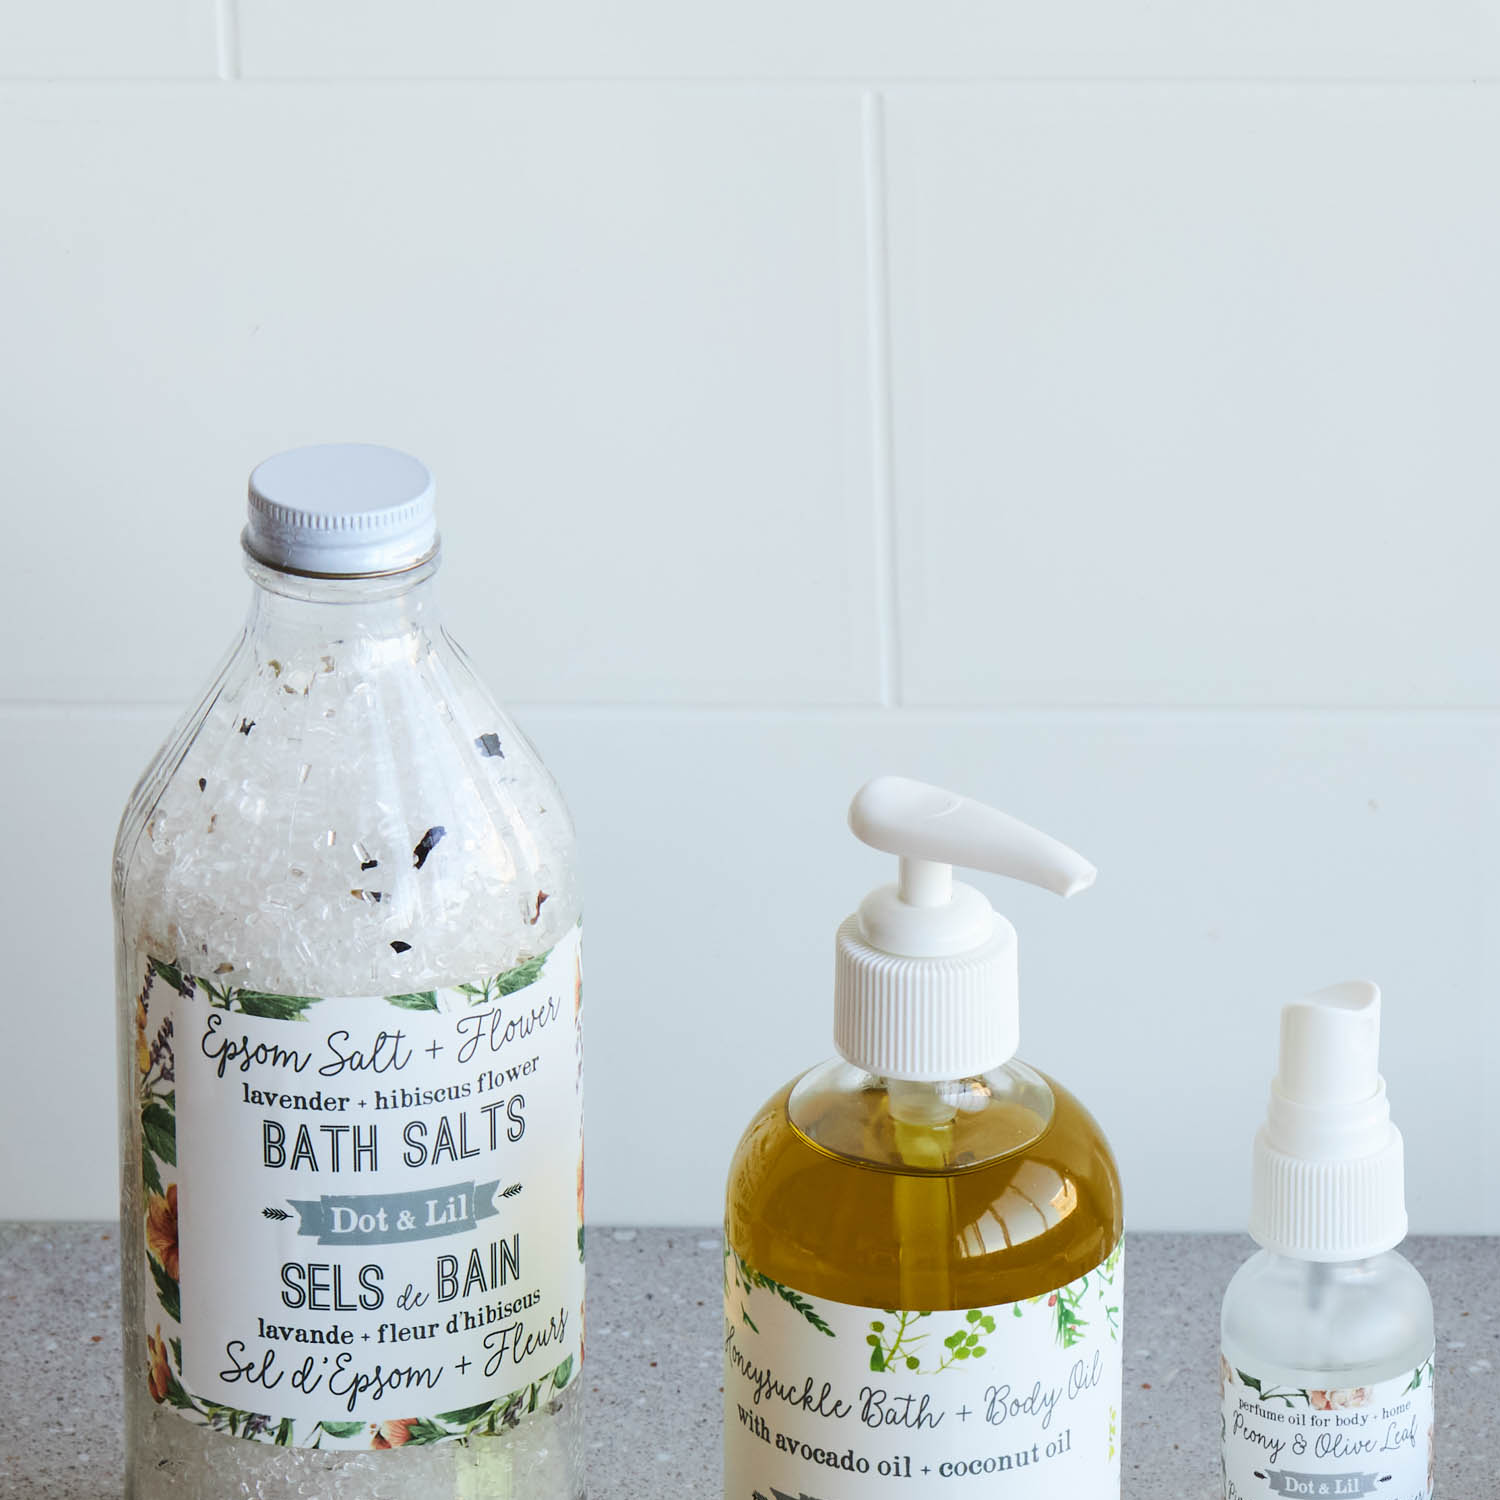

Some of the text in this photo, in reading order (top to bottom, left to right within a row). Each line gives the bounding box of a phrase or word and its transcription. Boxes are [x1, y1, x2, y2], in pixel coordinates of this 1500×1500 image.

[201, 996, 561, 1078] Epsom Salt + Flower
[242, 1056, 540, 1111] lavender + hibiscus flower
[263, 1094, 526, 1173] BATH SALTS
[330, 1195, 468, 1233] Dot & Lil
[280, 1233, 520, 1312] SELS de BAIN
[257, 1290, 541, 1345] lavande + fleur d'hibiscus
[219, 1307, 569, 1412] Sel d'Epsom + Fleurs
[860, 1386, 944, 1429] Bath
[956, 1404, 973, 1422] +
[984, 1381, 1063, 1430] Body
[1067, 1349, 1103, 1400] Oil
[737, 1403, 1072, 1478] with avocado oil + coconut oil
[1233, 1410, 1418, 1464] Peony & Olive Leaf
[1238, 1398, 1285, 1422] perfume
[1288, 1413, 1306, 1426] oil
[1311, 1415, 1331, 1427] for
[1335, 1413, 1368, 1427] body
[1382, 1400, 1411, 1420] home
[1285, 1476, 1360, 1494] Dot & Lil
